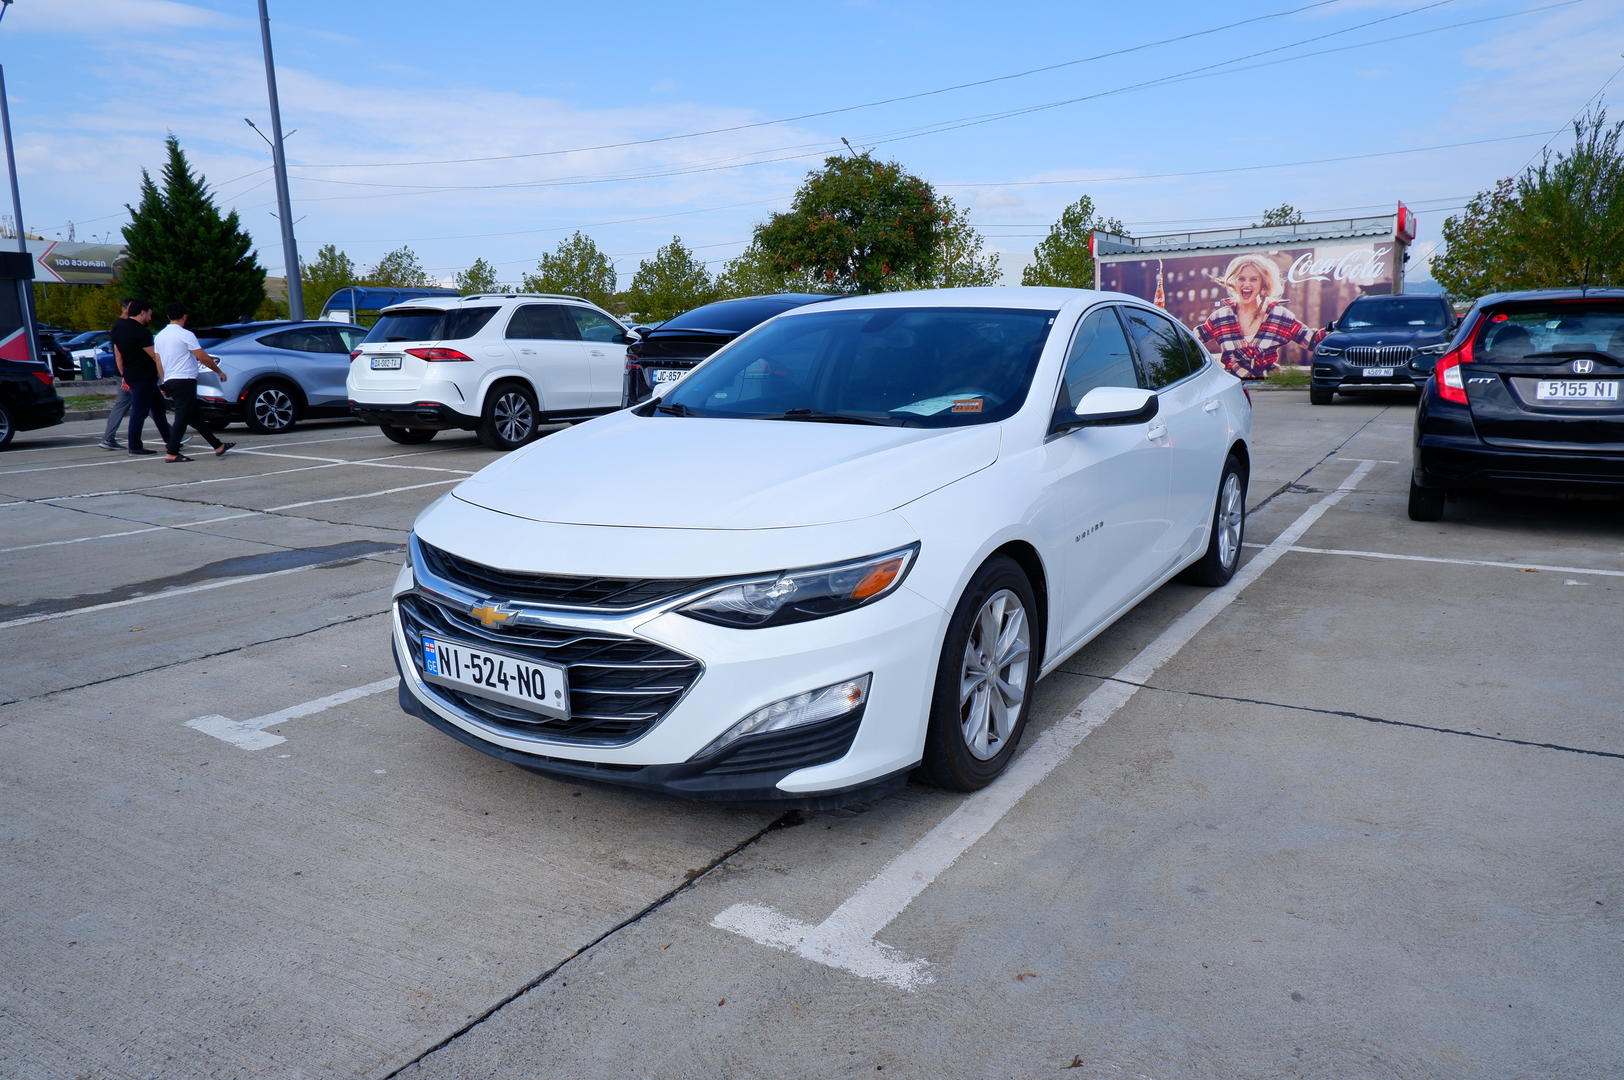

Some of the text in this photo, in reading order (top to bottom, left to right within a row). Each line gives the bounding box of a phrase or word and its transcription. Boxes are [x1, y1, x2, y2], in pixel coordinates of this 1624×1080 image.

[55, 258, 70, 266] 100
[657, 371, 687, 381] JC-857-
[1549, 382, 1612, 396] 5155 NI
[427, 659, 437, 672] GE
[437, 645, 546, 700] NI-524-NO
